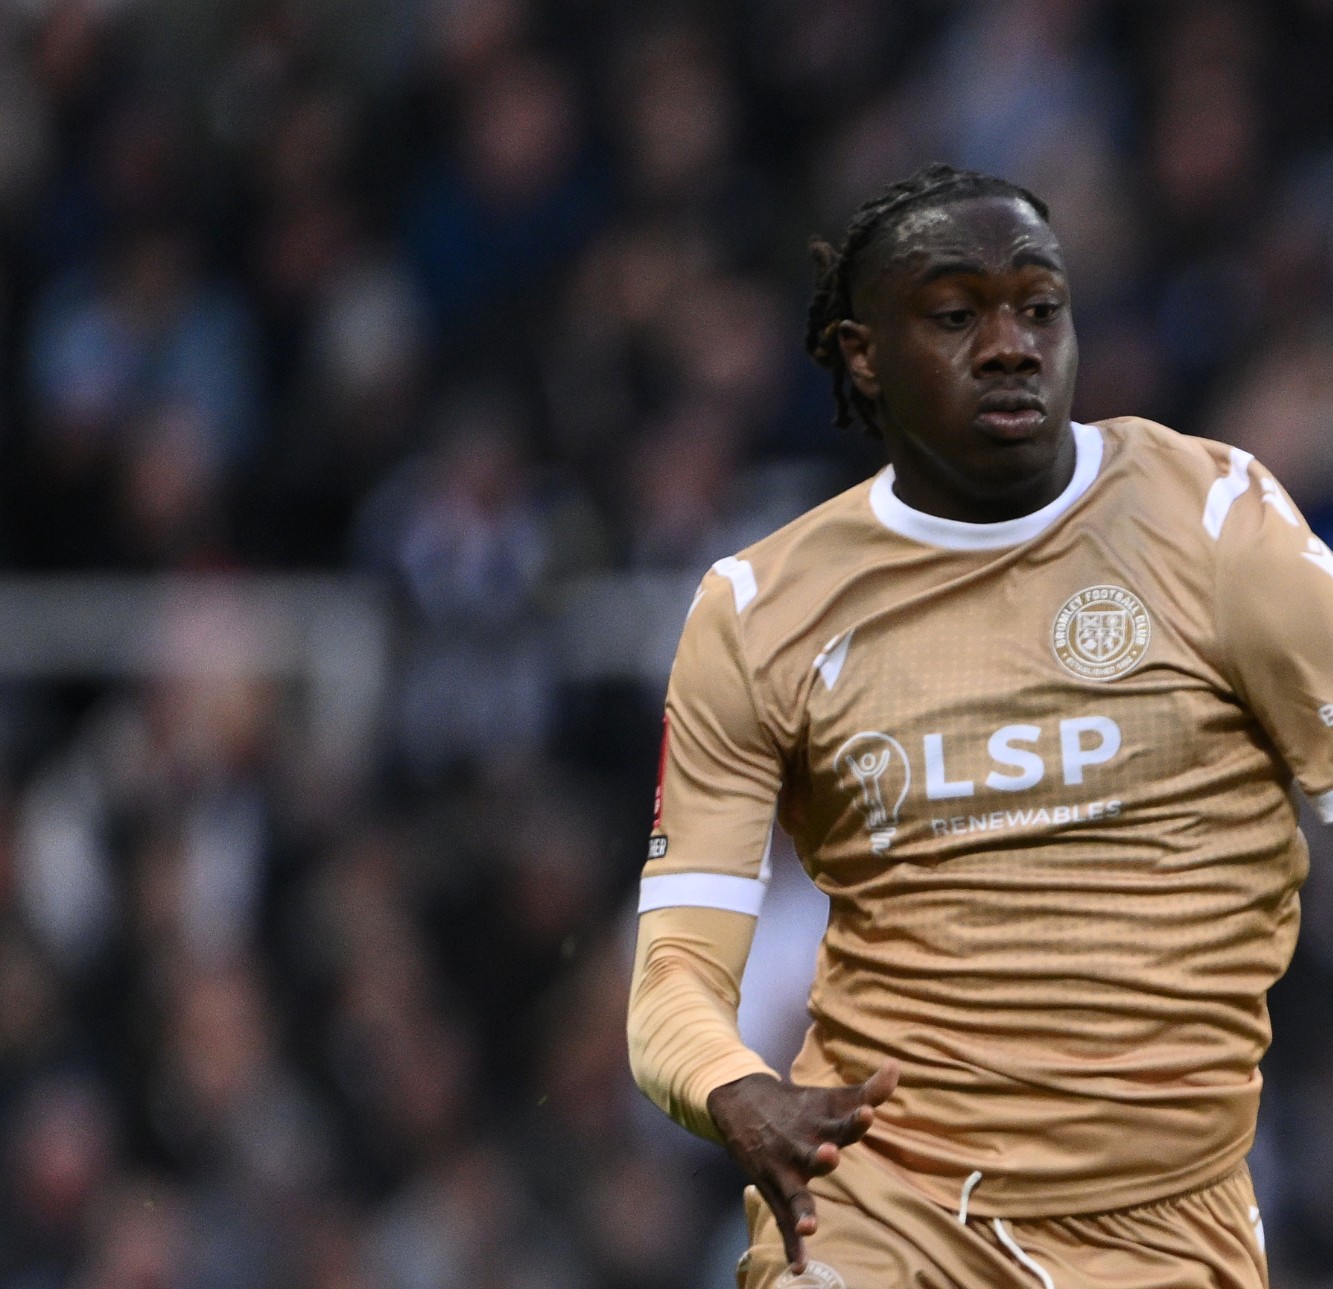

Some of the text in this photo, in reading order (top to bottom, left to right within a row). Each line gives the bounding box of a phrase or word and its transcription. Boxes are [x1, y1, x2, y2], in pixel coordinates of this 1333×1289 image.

[1054, 588, 1148, 649] BROMLEY FOOTBALL CLUB
[923, 714, 1122, 800] LSP
[930, 800, 1122, 838] RENEWABLES
